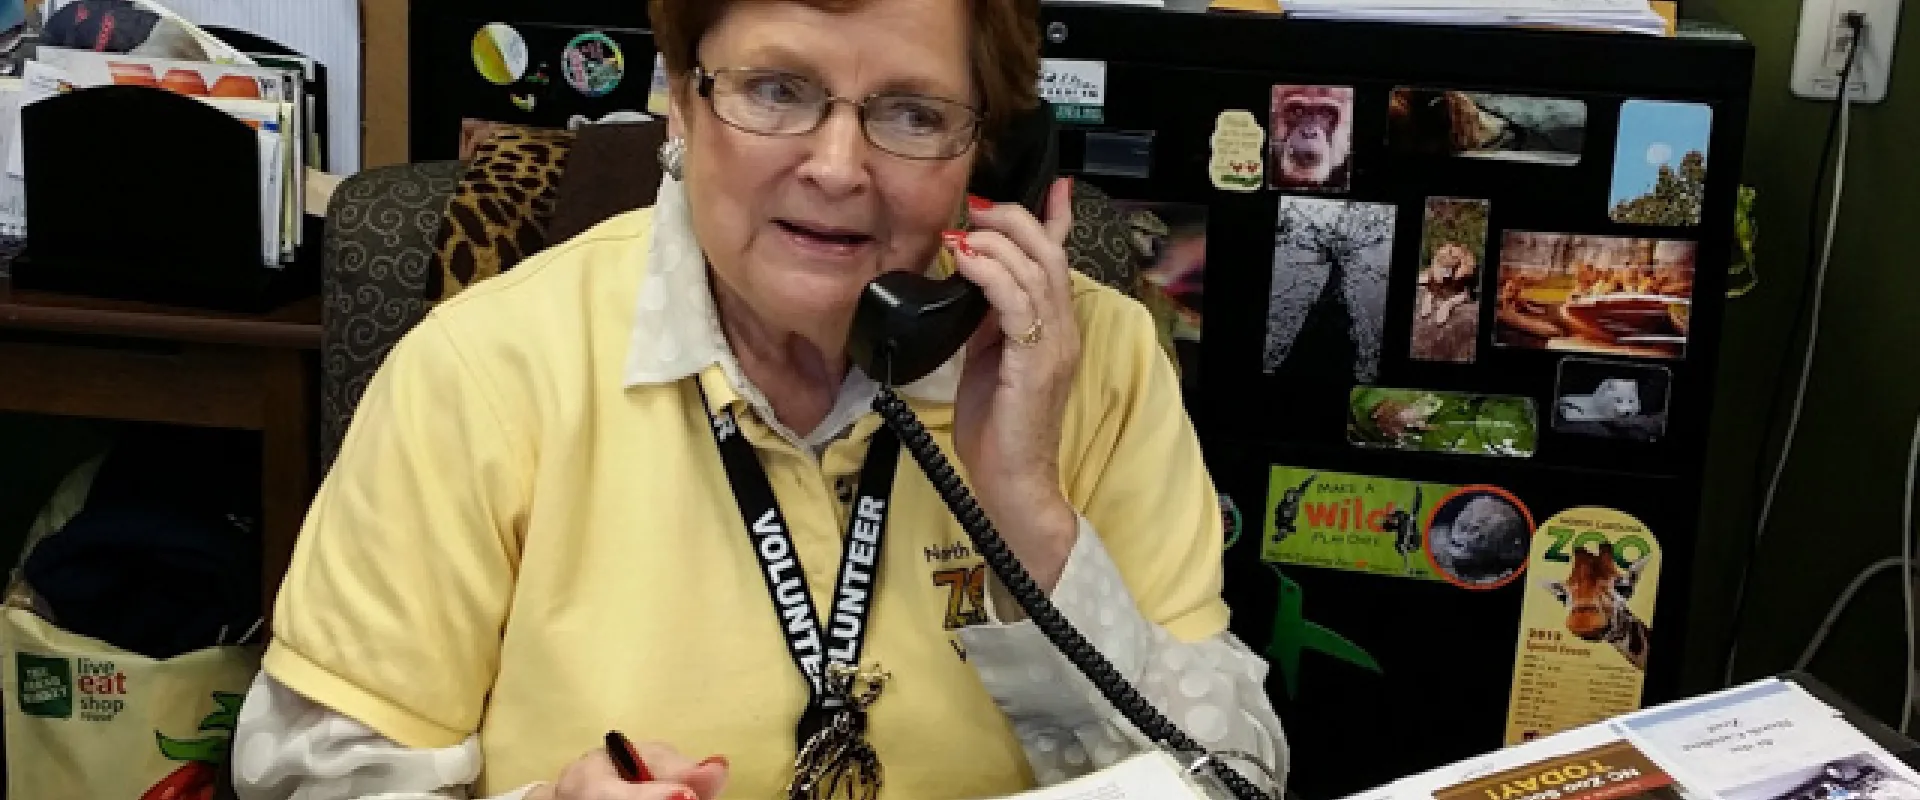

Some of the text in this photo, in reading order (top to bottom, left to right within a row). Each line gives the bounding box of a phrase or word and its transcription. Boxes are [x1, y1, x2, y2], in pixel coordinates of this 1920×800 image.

[1365, 484, 1376, 494] A
[923, 541, 969, 562] North
[1543, 525, 1651, 568] ZOO
[77, 658, 115, 674] live
[78, 671, 126, 694] eat
[80, 696, 123, 715] shop
